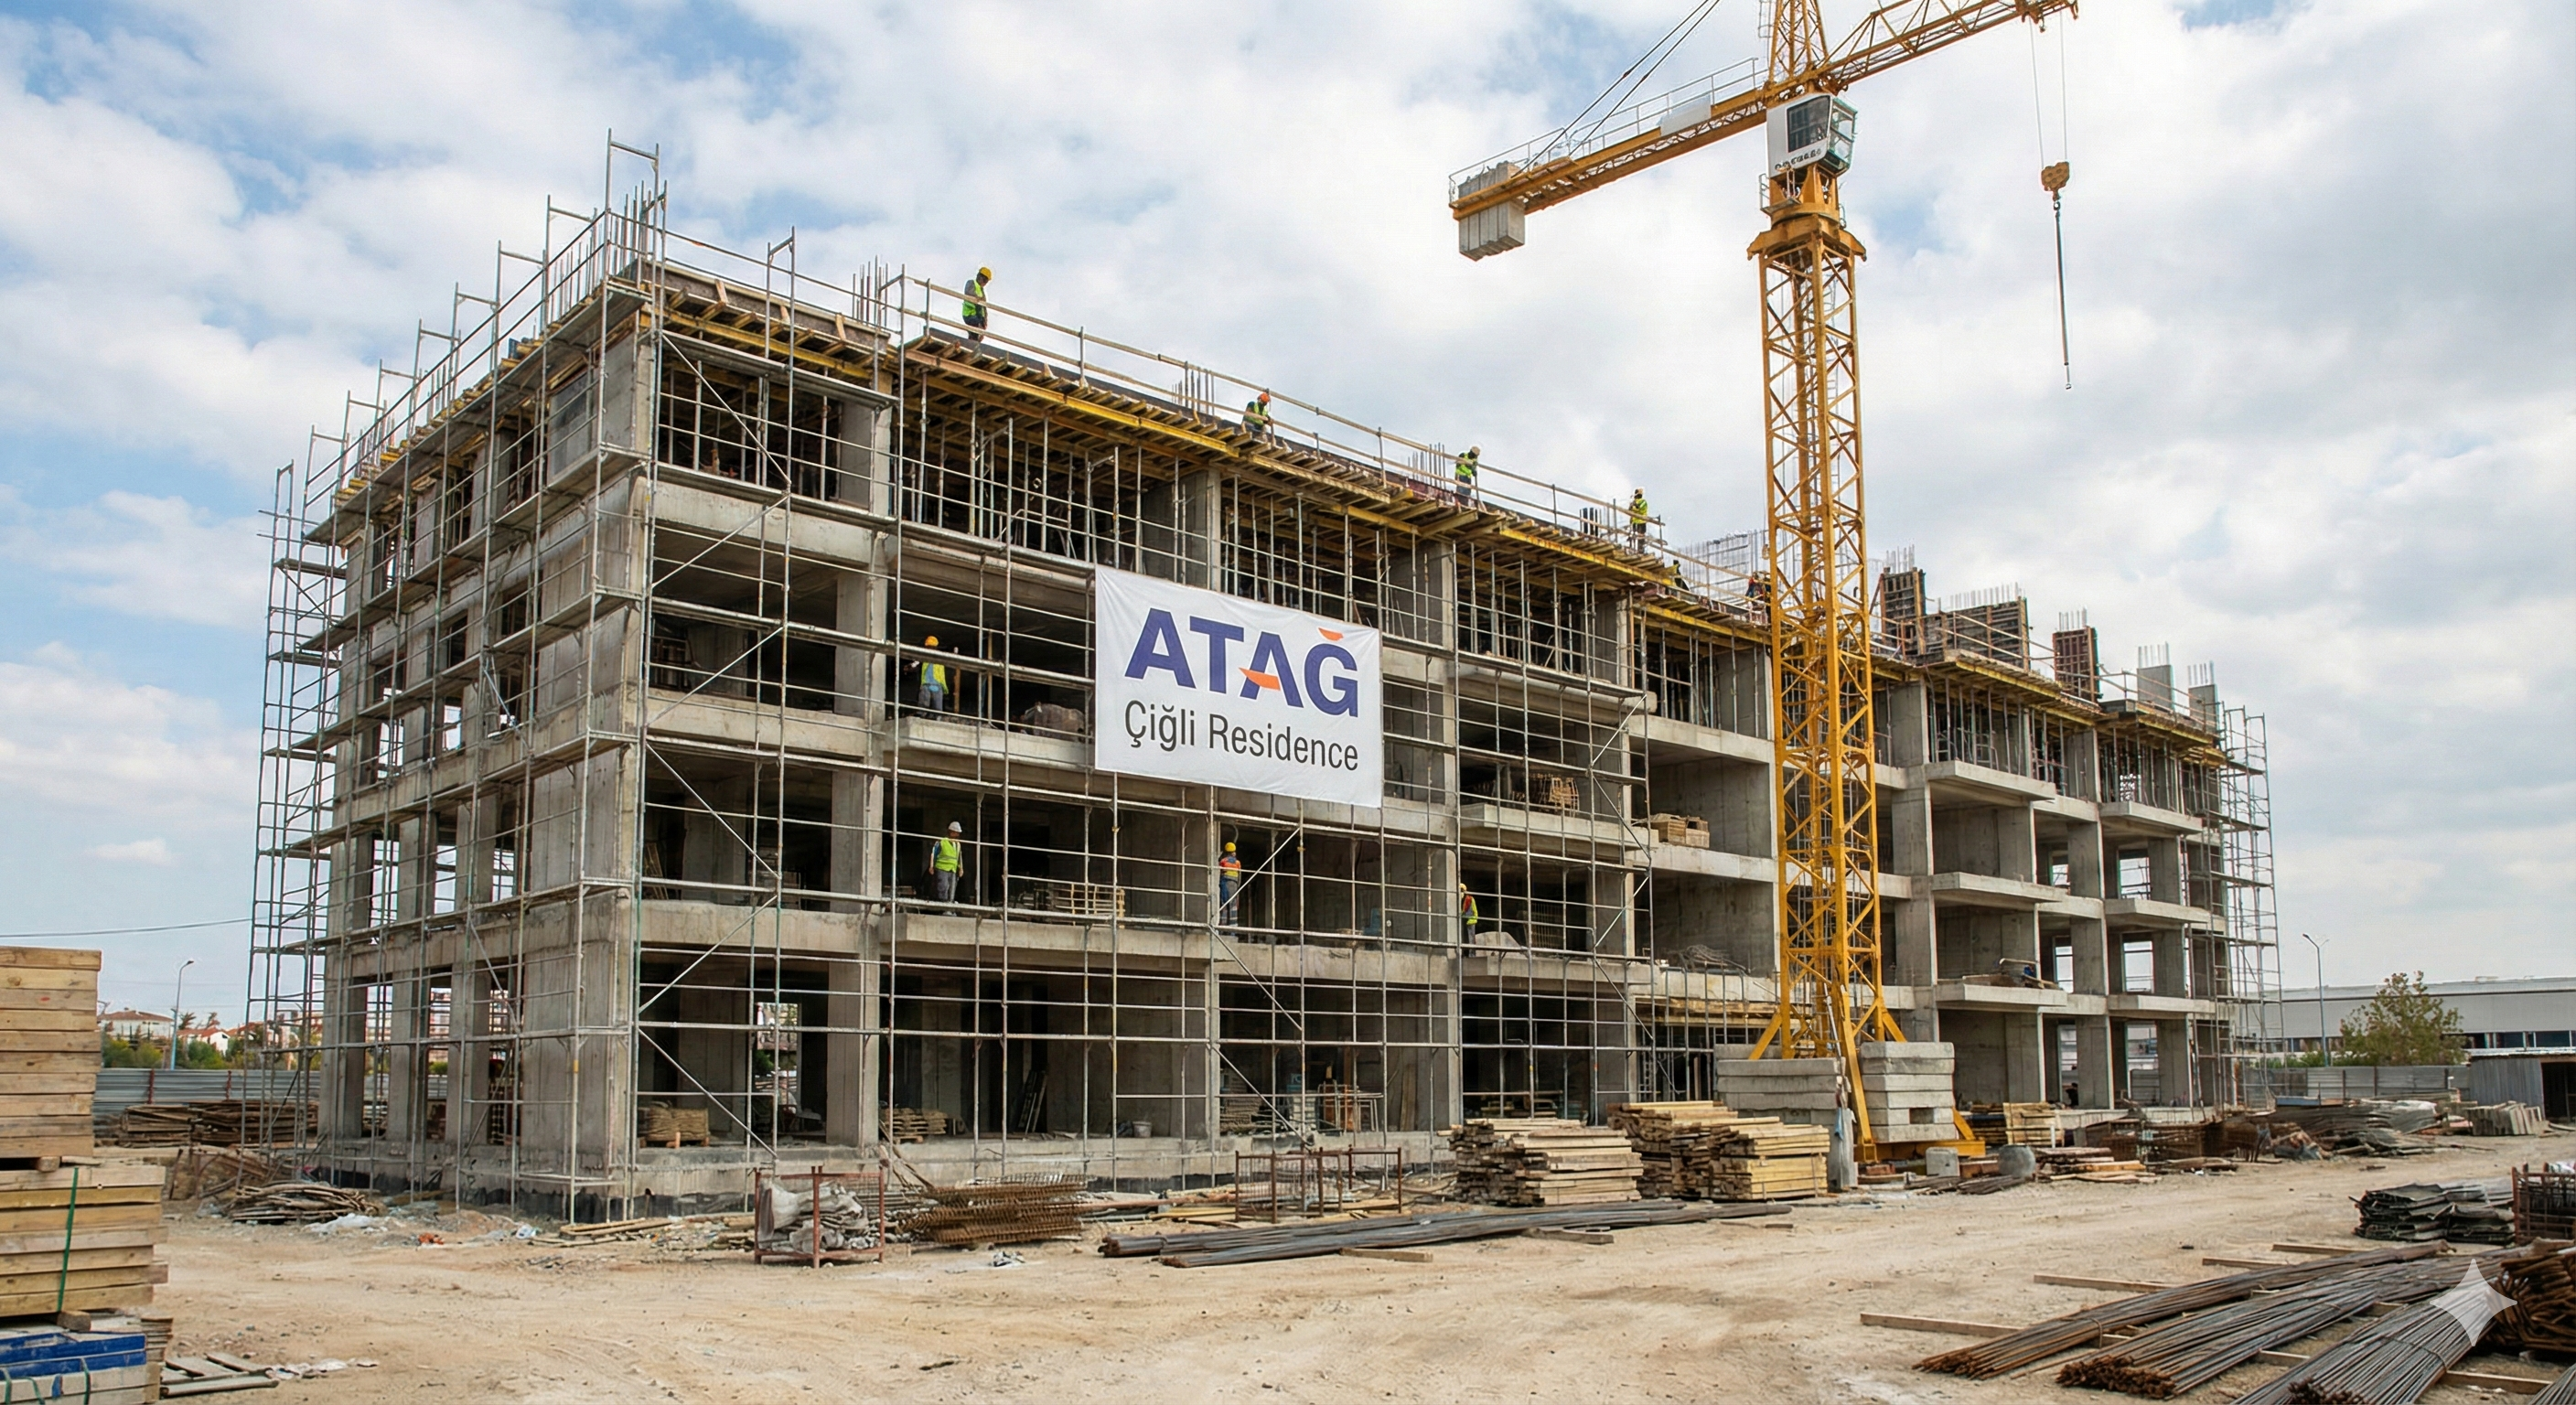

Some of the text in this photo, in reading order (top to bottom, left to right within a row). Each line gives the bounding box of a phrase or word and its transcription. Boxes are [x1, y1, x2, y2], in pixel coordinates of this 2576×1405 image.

[1124, 607, 1358, 718] ATAĞ
[1124, 700, 1359, 771] Çiğli Residence
